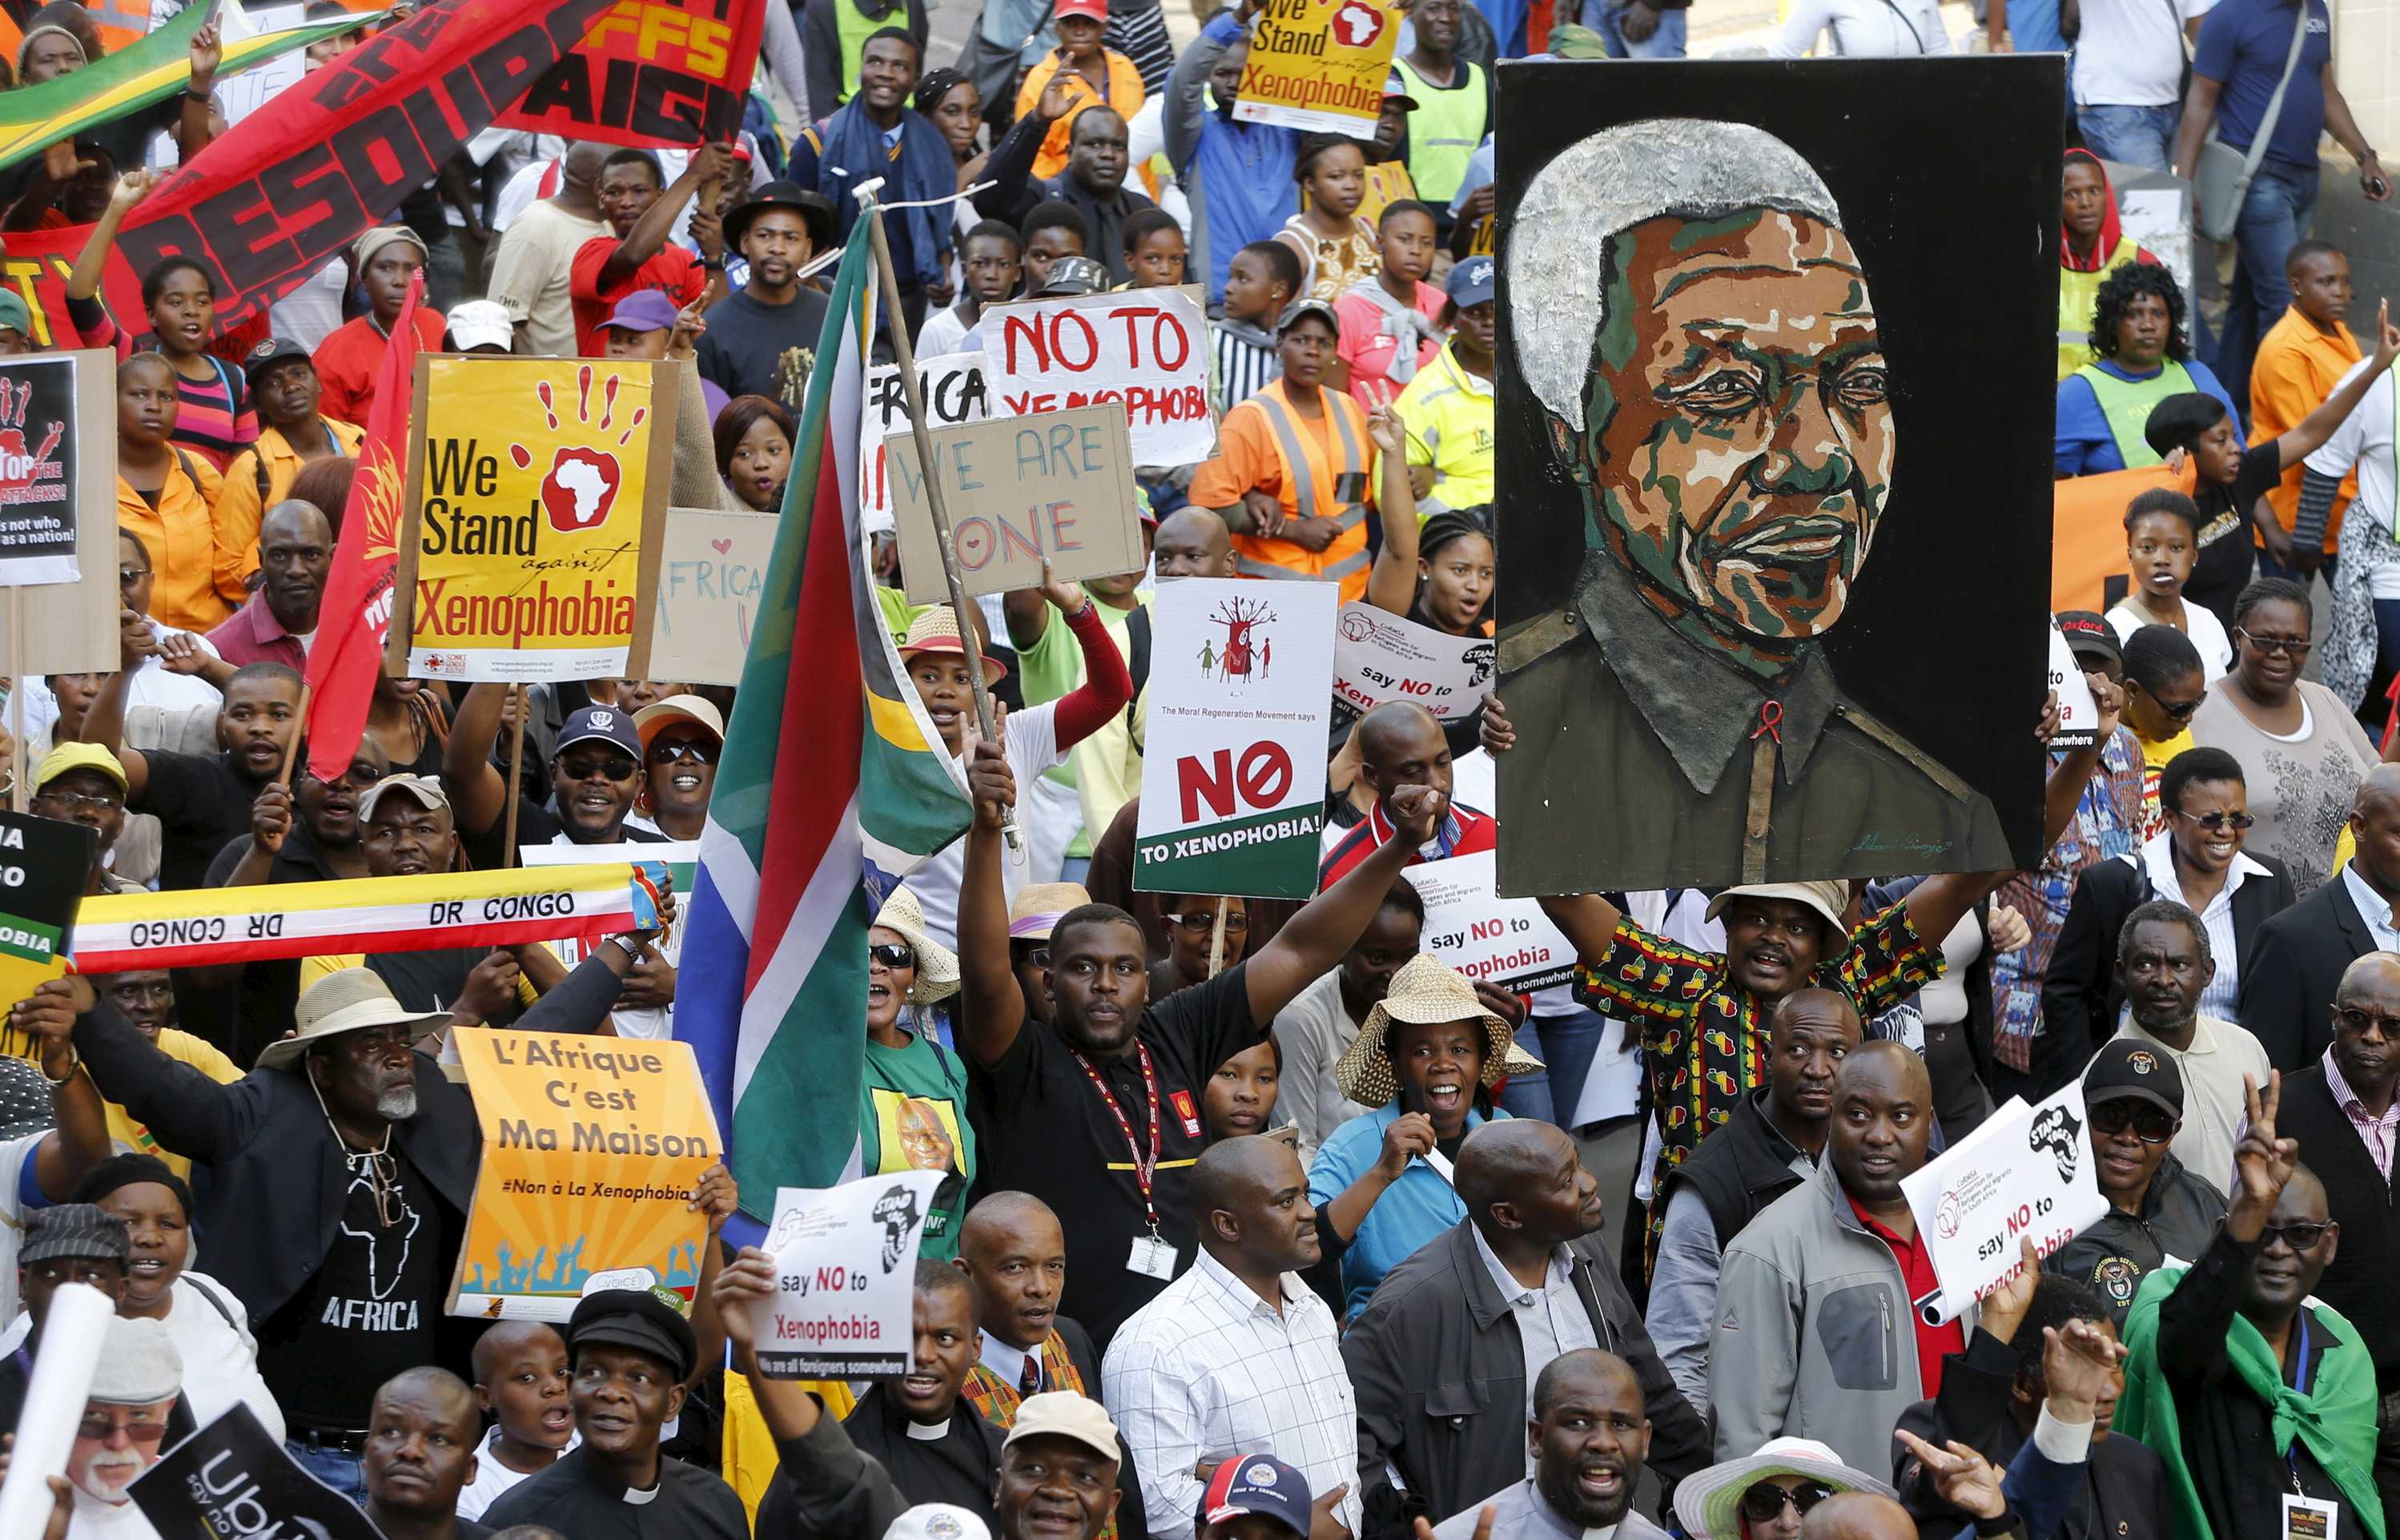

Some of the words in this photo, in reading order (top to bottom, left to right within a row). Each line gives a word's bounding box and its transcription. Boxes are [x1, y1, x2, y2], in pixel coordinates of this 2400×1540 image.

[1253, 19, 1329, 56] Stand
[1240, 62, 1384, 113] Xenophobia
[1003, 309, 1099, 375] NO
[1109, 308, 1189, 372] TO
[35, 462, 63, 479] THE
[428, 439, 497, 497] We
[897, 440, 984, 505] WE
[1015, 424, 1103, 480] ARE
[0, 484, 67, 505] ATTACKS!
[2, 534, 17, 545] as
[18, 533, 26, 545] a
[29, 529, 75, 544] nation!
[10, 518, 31, 531] not
[34, 516, 62, 529] who
[422, 497, 539, 556] Stand
[954, 501, 1083, 572] ONE
[509, 541, 640, 597] against
[413, 579, 636, 649] Xenophobia
[2063, 619, 2104, 633] Oxford
[1361, 666, 1396, 689] say
[1399, 678, 1433, 696] NO
[1435, 686, 1452, 696] to
[2050, 669, 2063, 684] to
[1161, 706, 1176, 716] The
[1178, 707, 1200, 717] Moral
[1202, 708, 1253, 721] Regeneration
[1256, 710, 1296, 720] Movement
[1297, 713, 1316, 722] says
[1176, 740, 1292, 824] NO
[0, 825, 24, 850] A
[1140, 844, 1169, 866] TO
[1174, 815, 1321, 860] XENOPHOBIA!
[0, 865, 26, 887] O
[430, 902, 463, 927] DR
[484, 892, 574, 921] CONGO
[130, 918, 225, 947] CONGO
[248, 913, 284, 939] DR
[1431, 931, 1465, 949] say
[1471, 919, 1504, 941] NO
[1510, 919, 1530, 933] to
[492, 1039, 663, 1079] L'Afrique
[545, 1080, 637, 1111] C'est
[499, 1118, 557, 1152] Ma
[573, 1122, 707, 1158] Maison
[2031, 1109, 2064, 1145] STAND
[502, 1179, 545, 1196] #Non
[553, 1180, 562, 1196] à
[568, 1181, 585, 1196] La
[592, 1182, 691, 1204] Xenophobia
[1978, 1231, 2003, 1261] say
[2006, 1204, 2031, 1239] NO
[2036, 1196, 2052, 1217] to
[1973, 1228, 2073, 1302] Xenopobia
[2119, 1257, 2141, 1276] SERVICES
[653, 1288, 680, 1305] YOUTH
[782, 1275, 810, 1297] say
[815, 1267, 845, 1292] NO
[851, 1271, 867, 1291] to
[321, 1296, 419, 1332] AFRICA
[2117, 1299, 2131, 1308] EST
[775, 1314, 880, 1345] Xenophobia
[773, 1361, 786, 1373] are
[787, 1358, 798, 1373] all
[799, 1357, 846, 1377] foreigners
[847, 1359, 904, 1374] somewhere
[187, 1474, 212, 1506] say
[208, 1509, 232, 1534] no
